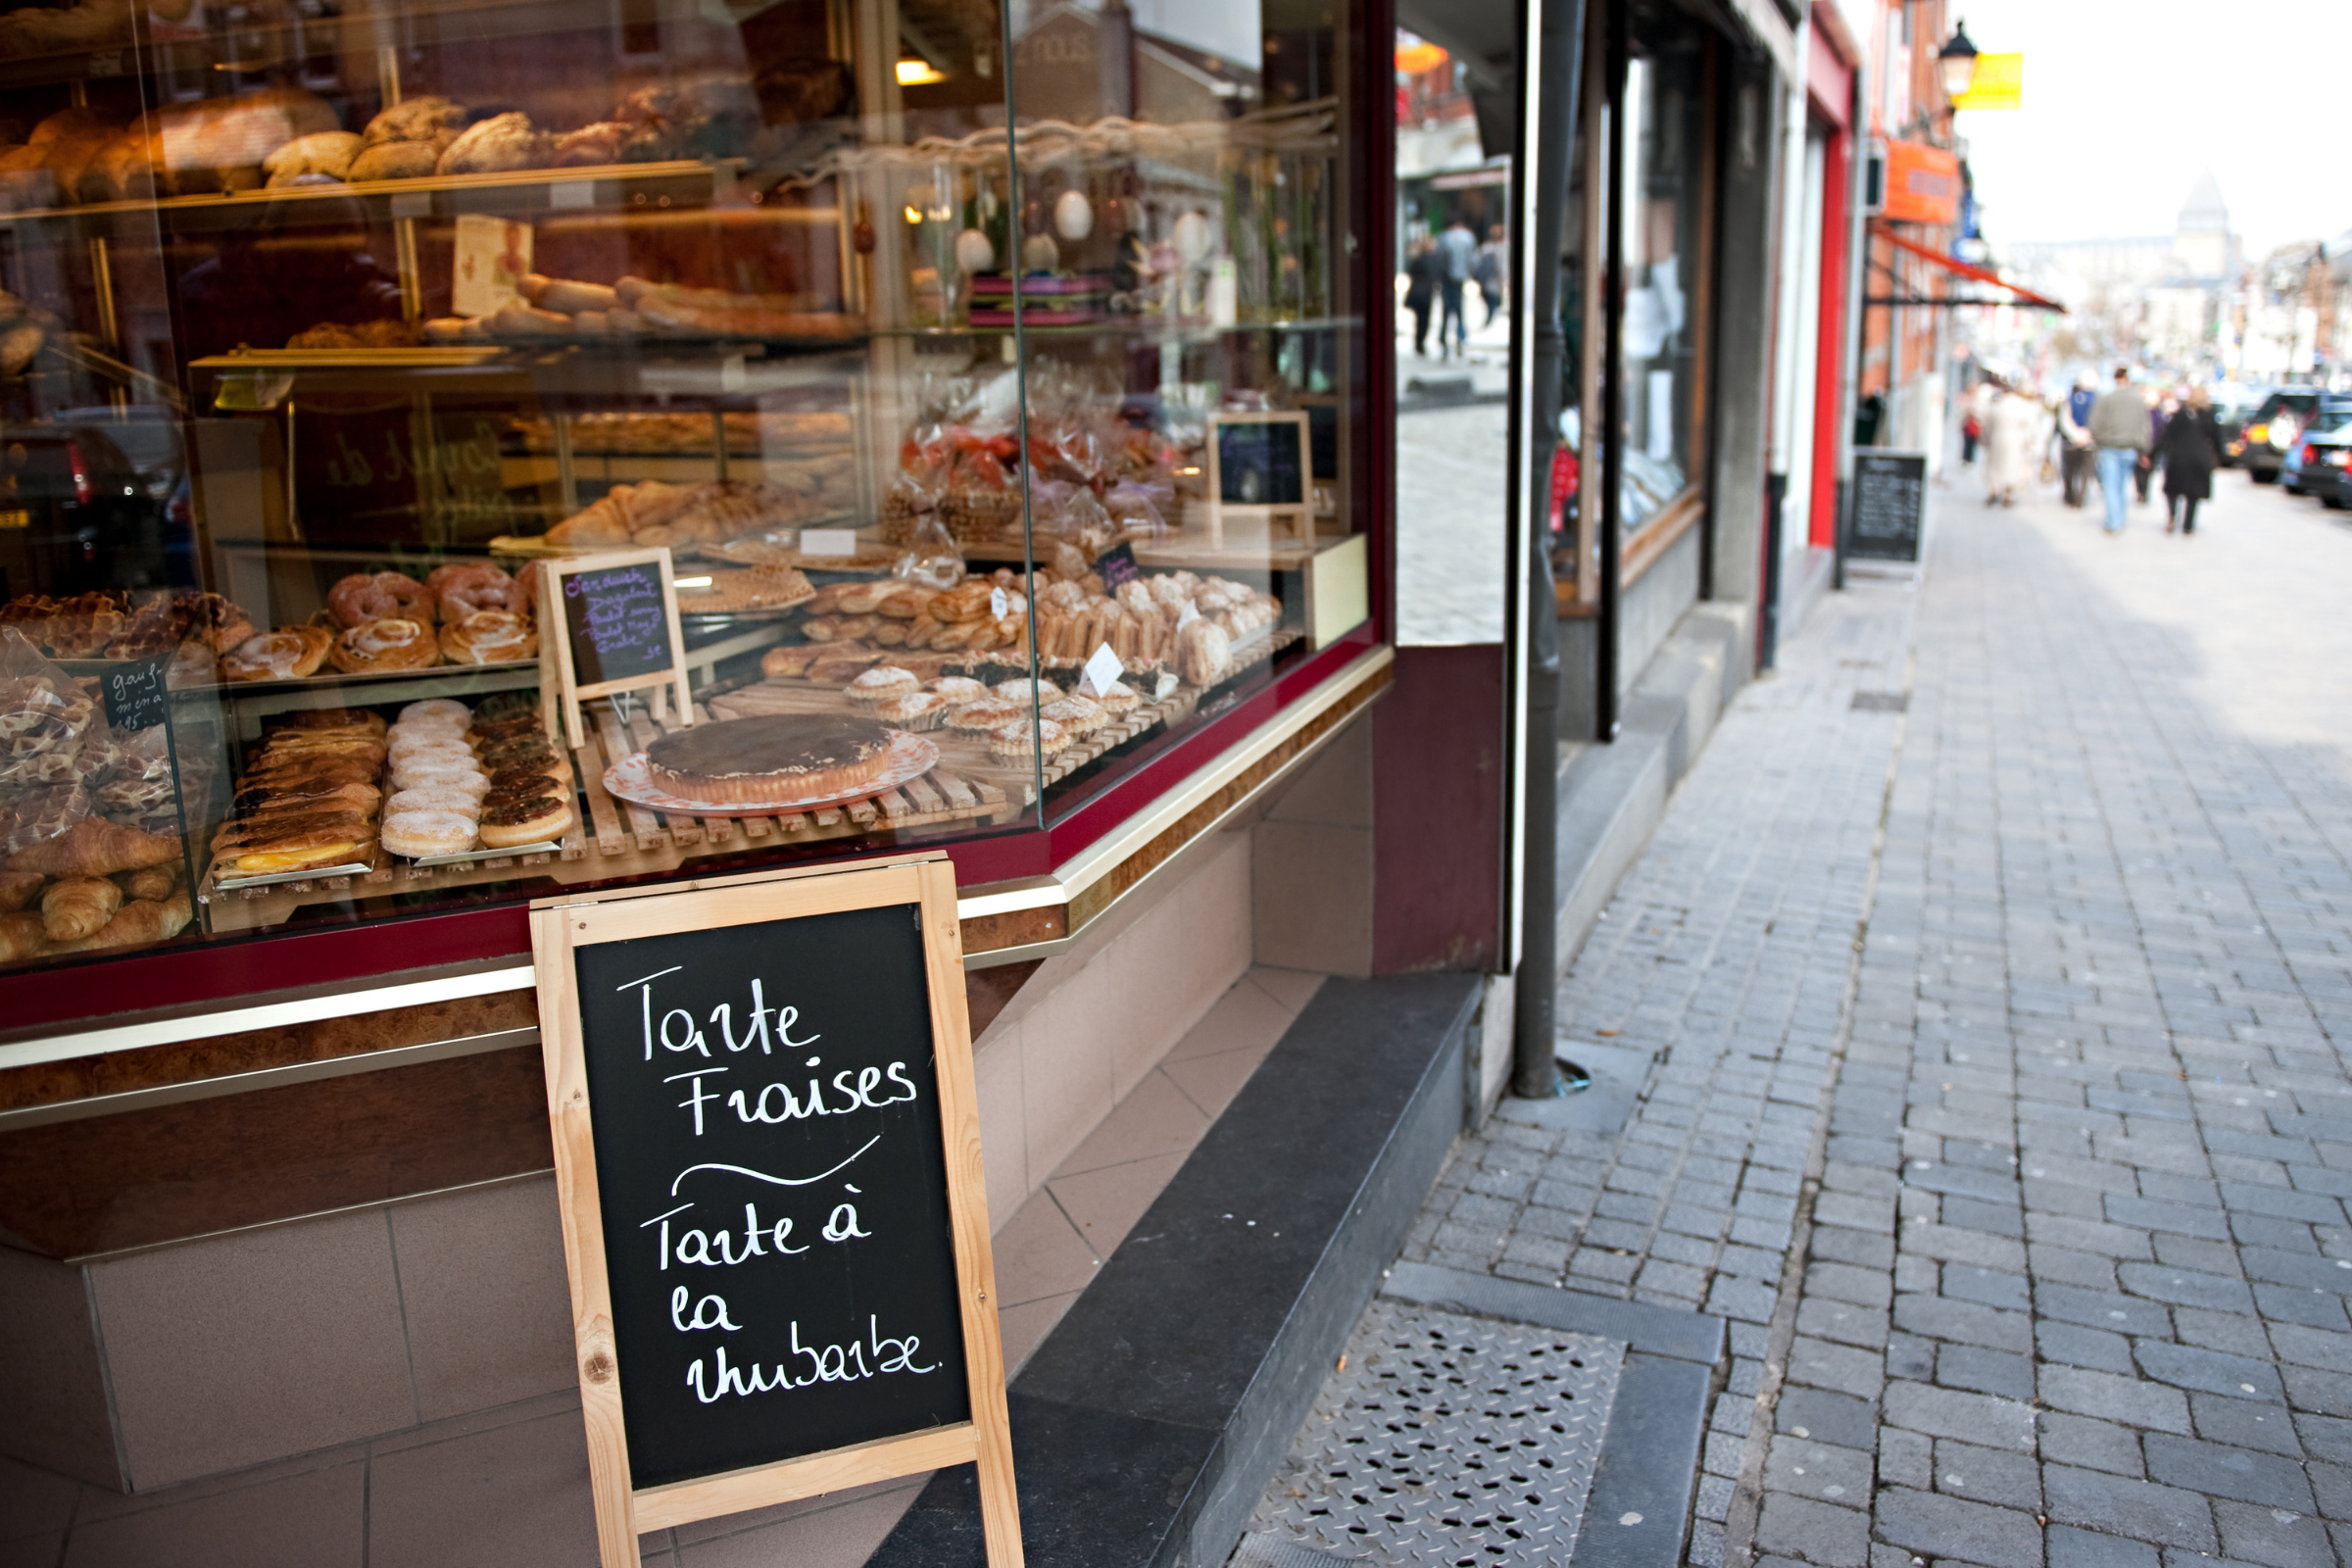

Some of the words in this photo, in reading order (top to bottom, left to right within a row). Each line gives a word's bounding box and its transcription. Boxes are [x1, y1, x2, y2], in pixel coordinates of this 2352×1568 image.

[616, 965, 821, 1061] Tarte
[663, 1056, 917, 1137] Fraises
[640, 1203, 810, 1271] Tarte
[822, 1184, 872, 1245] à
[672, 1286, 744, 1332] la
